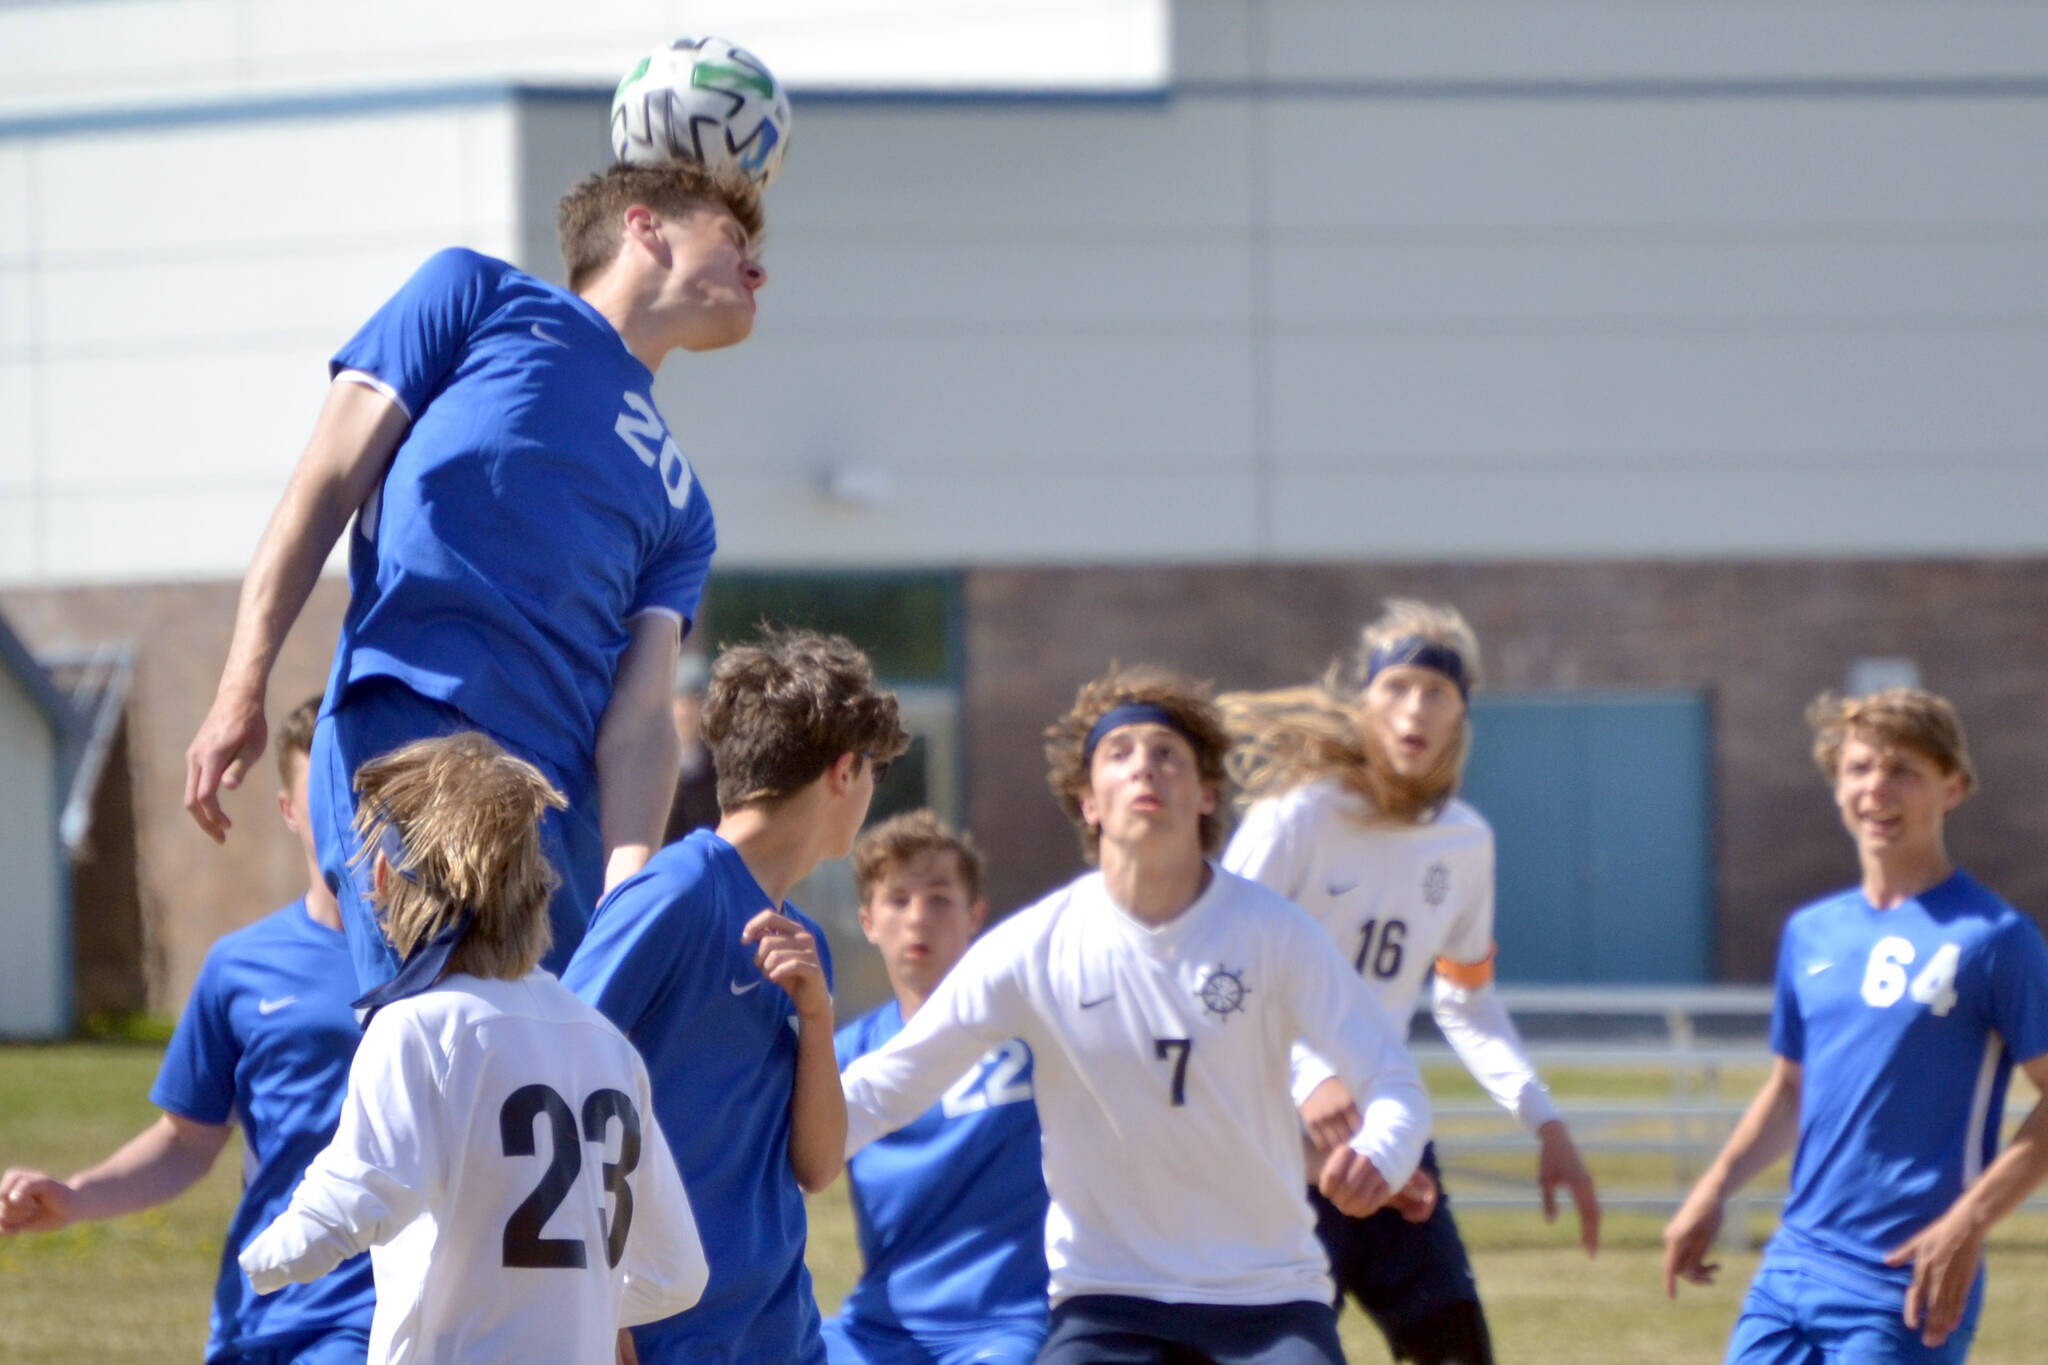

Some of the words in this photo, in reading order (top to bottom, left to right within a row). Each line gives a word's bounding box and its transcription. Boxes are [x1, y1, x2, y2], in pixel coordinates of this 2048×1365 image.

[614, 389, 691, 510] 20
[1355, 918, 1407, 980] 16
[1861, 936, 1961, 1017] 64
[942, 1039, 1033, 1119] 22
[1154, 1037, 1191, 1107] 7
[500, 1083, 641, 1269] 23
